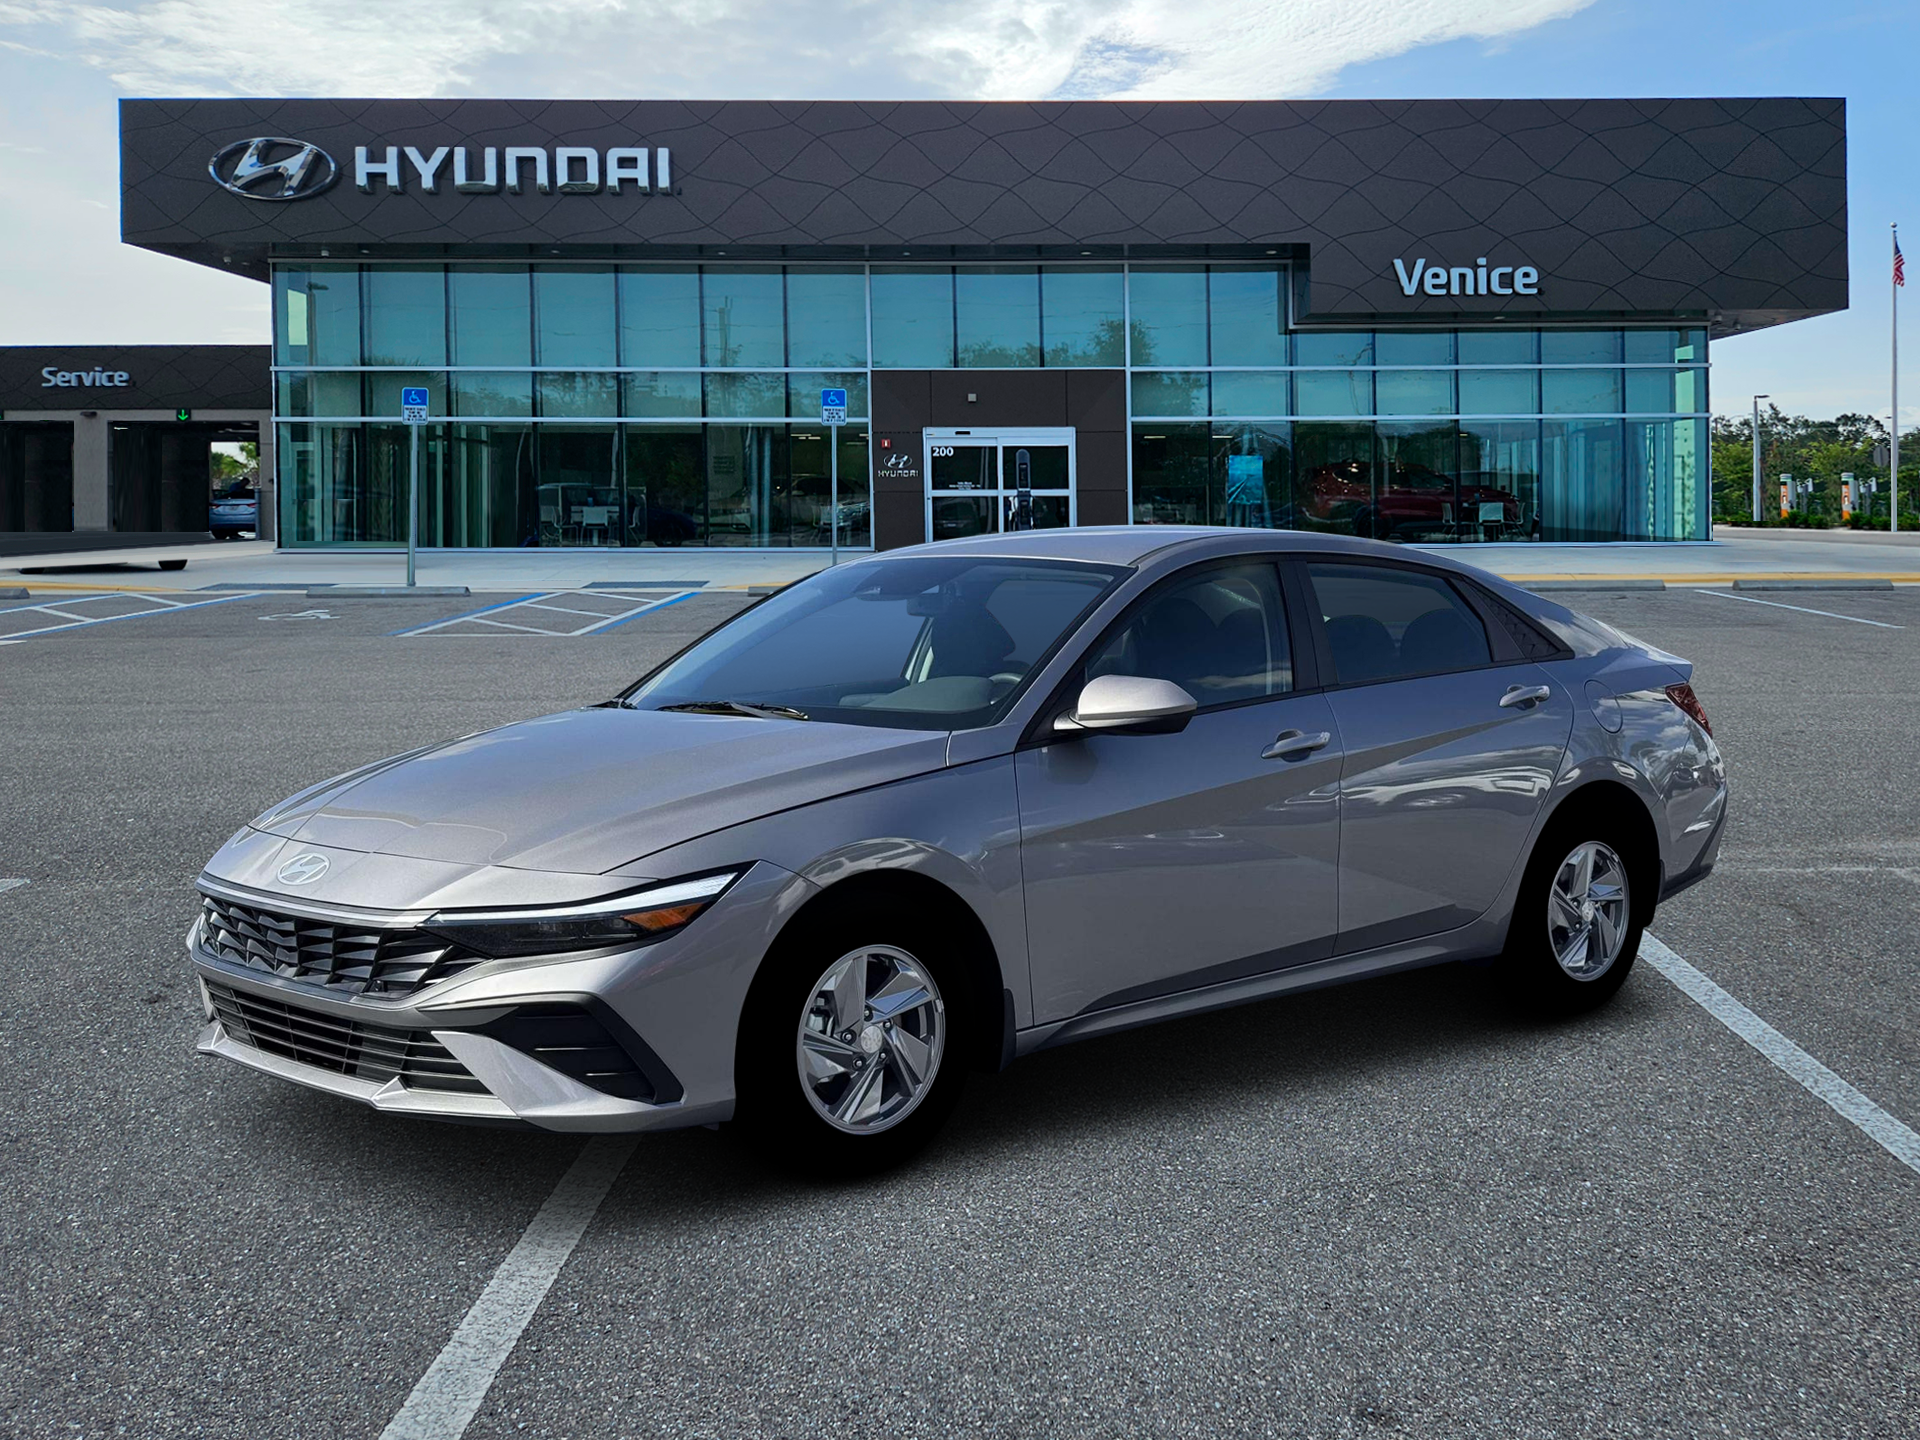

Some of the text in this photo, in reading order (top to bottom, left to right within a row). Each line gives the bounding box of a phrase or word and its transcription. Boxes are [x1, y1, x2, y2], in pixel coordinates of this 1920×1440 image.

[354, 146, 671, 195] HYUNDAI
[1392, 257, 1539, 296] Venice
[41, 366, 130, 387] Service
[932, 446, 954, 457] 200
[877, 469, 919, 478] HYUNDAI
